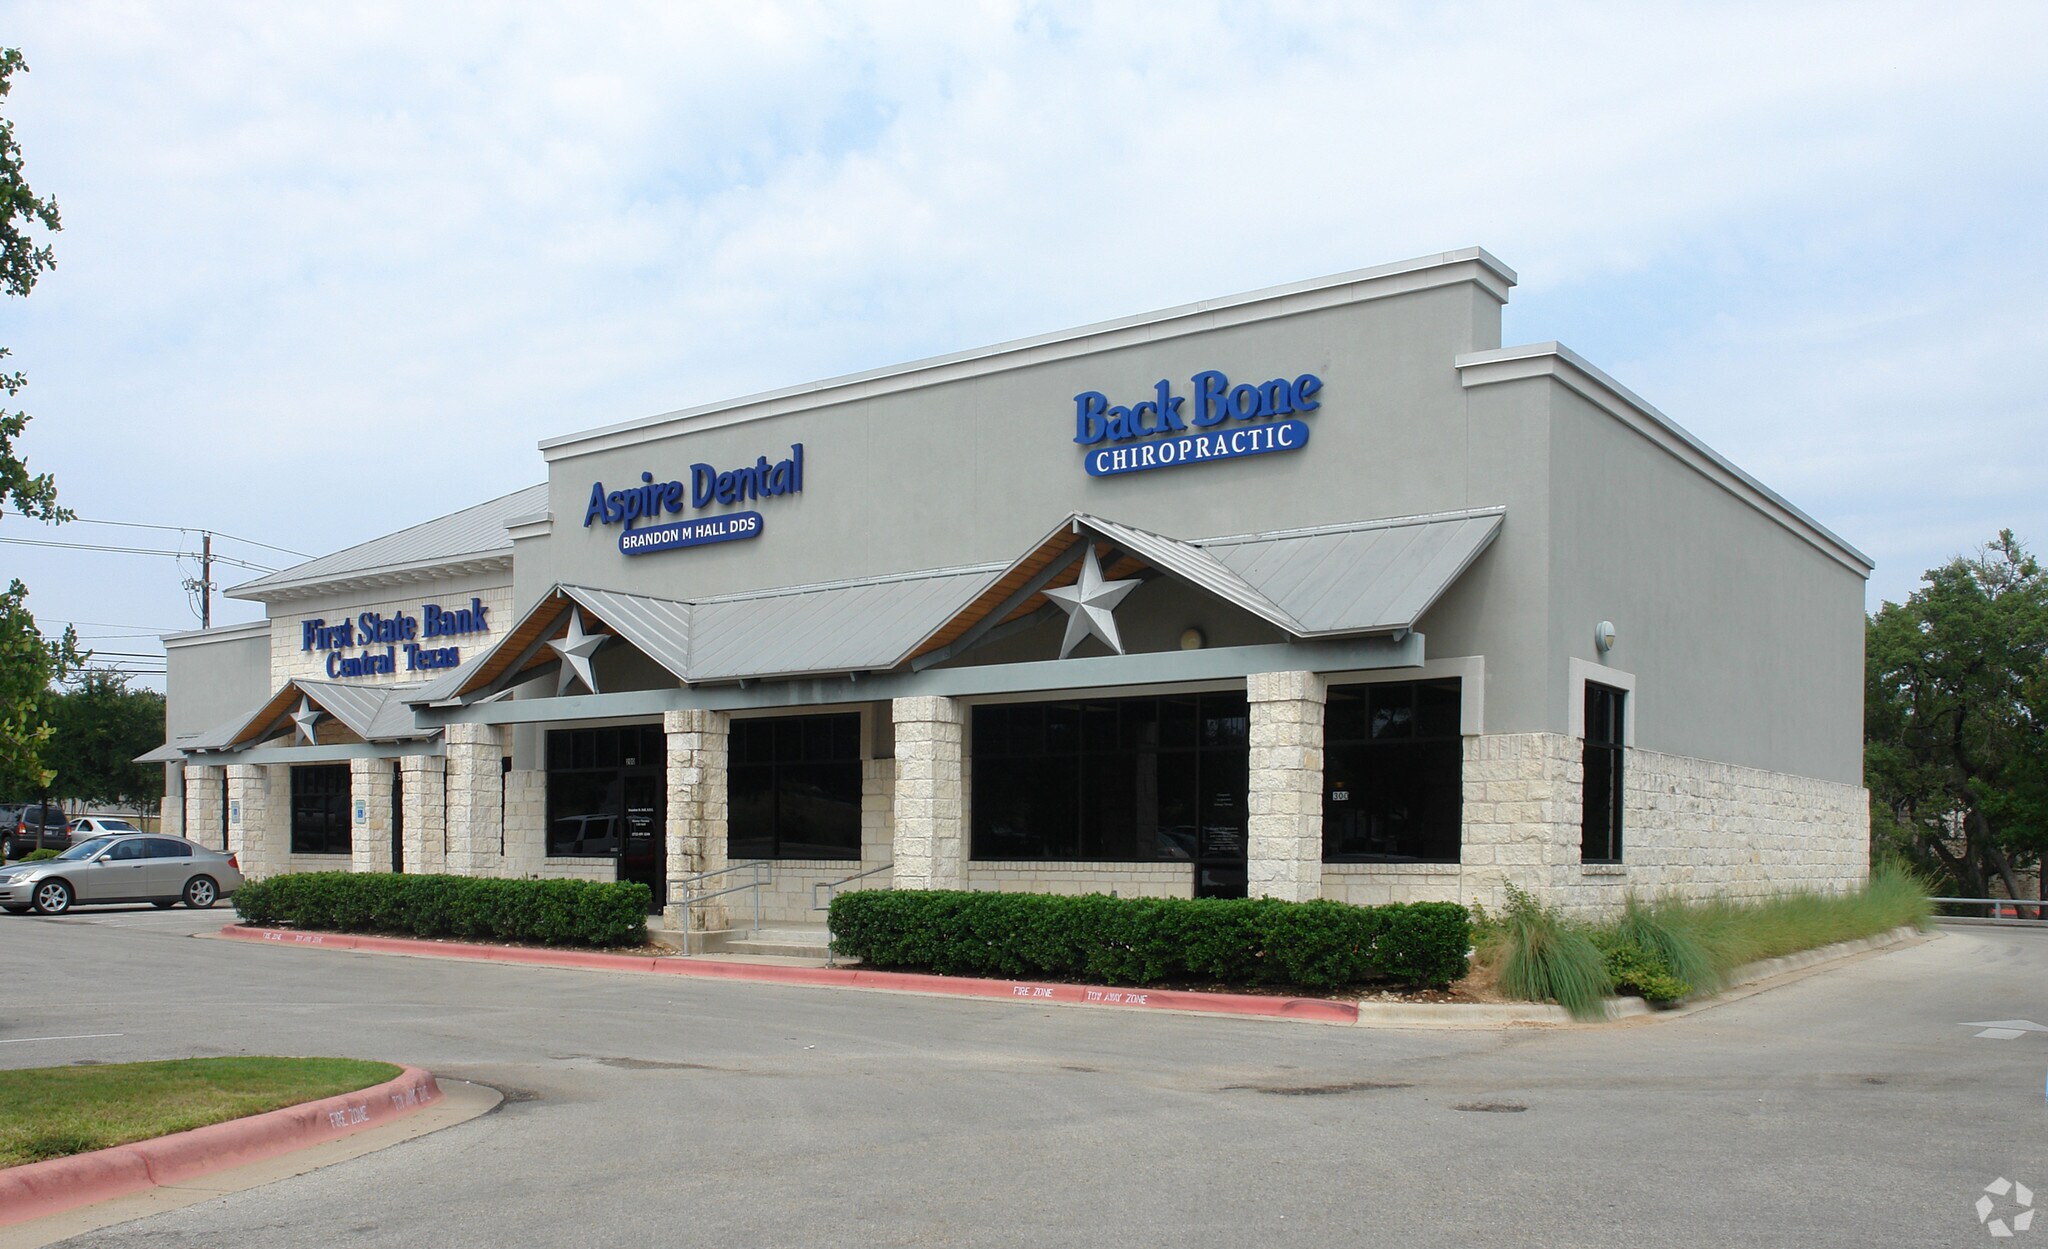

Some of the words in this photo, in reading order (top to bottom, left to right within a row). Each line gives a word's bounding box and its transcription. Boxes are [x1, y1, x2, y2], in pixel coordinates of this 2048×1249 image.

[1073, 379, 1188, 444] Back
[1190, 370, 1324, 427] Bone
[1096, 424, 1293, 472] CHIROPRACTIC
[583, 471, 684, 530] Aspire
[690, 442, 803, 509] Dental
[622, 529, 679, 549] BRANDON
[682, 527, 692, 540] M
[695, 521, 726, 537] HALL
[729, 517, 756, 532] DDS
[301, 617, 353, 651] First
[357, 610, 416, 646] State
[421, 598, 489, 638] Bank
[326, 646, 396, 678] Central
[403, 643, 460, 671] Texas
[1013, 986, 1030, 996] FIRE
[1033, 988, 1053, 998] ZONE
[1125, 993, 1148, 1005] ZONE
[329, 1110, 349, 1129] FIRE
[348, 1105, 370, 1125] ZONE
